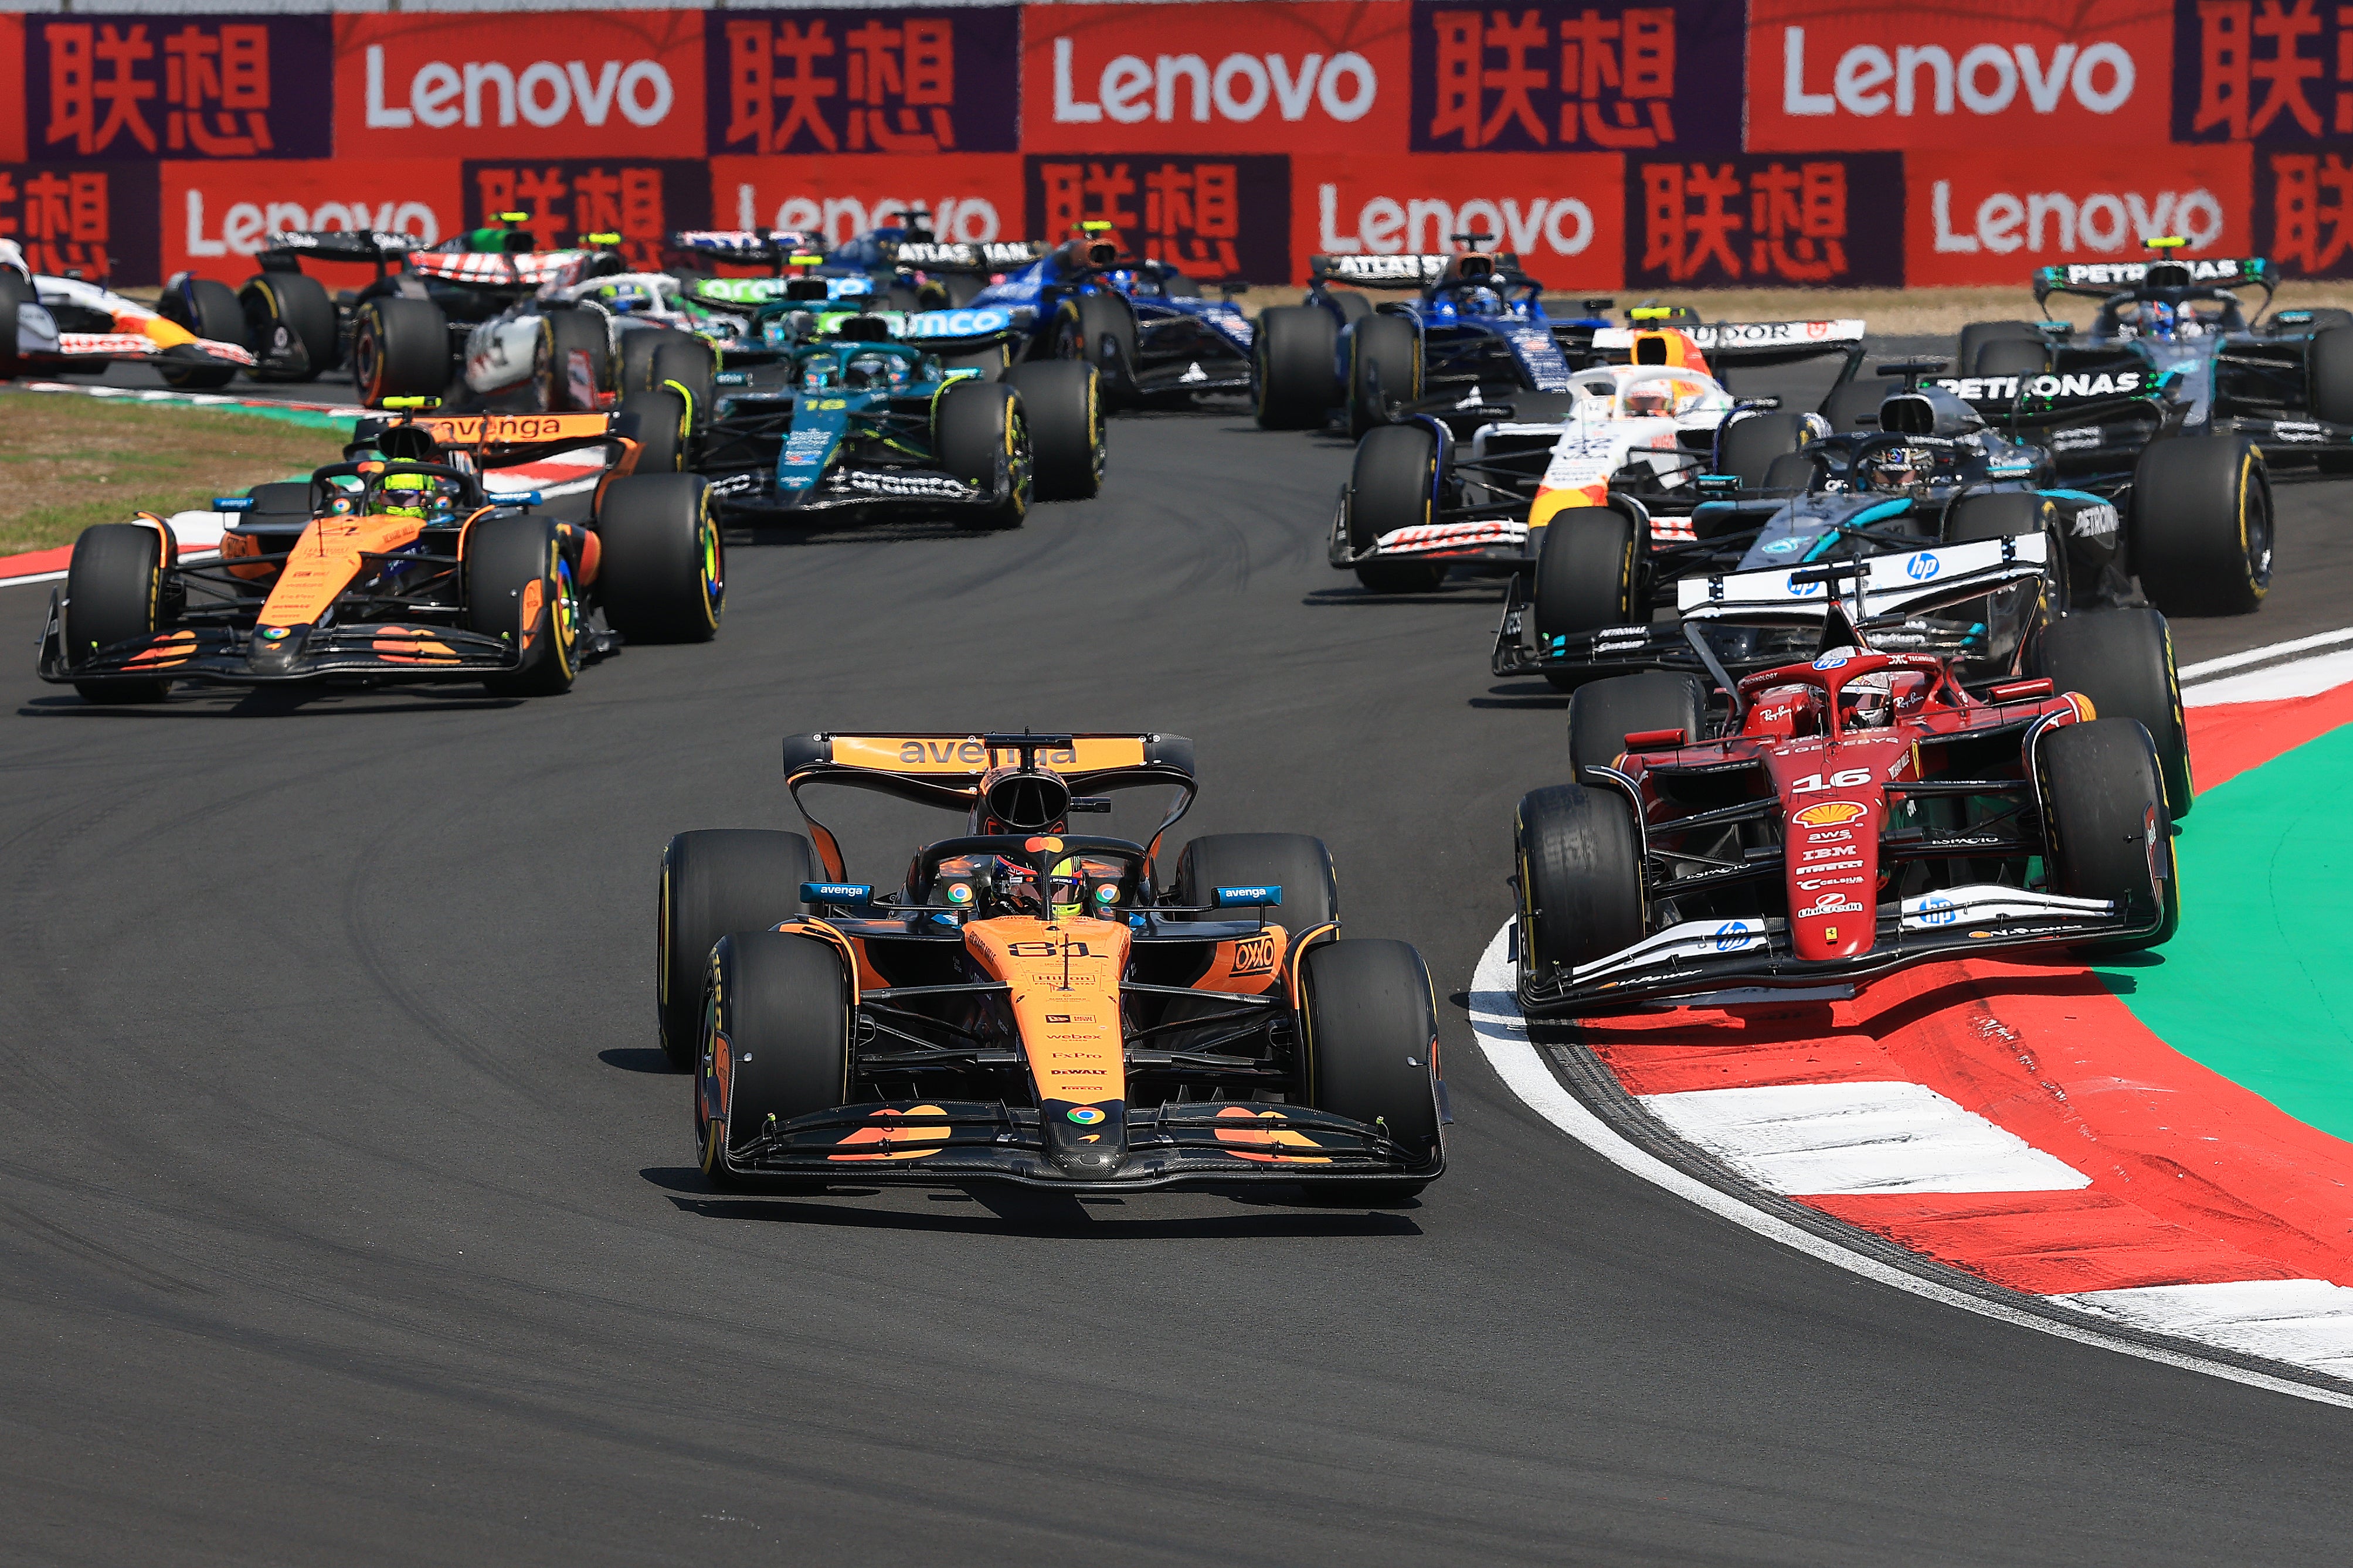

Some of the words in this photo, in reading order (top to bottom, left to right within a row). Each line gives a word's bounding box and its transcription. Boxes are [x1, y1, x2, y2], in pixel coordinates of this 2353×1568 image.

[44, 23, 274, 156] 联想
[365, 45, 674, 128] Lenovo
[725, 19, 957, 154] 联想
[1052, 37, 1377, 123] Lenovo
[1430, 8, 1677, 149] 联想
[1783, 26, 2136, 116] Lenovo
[2193, 0, 2353, 140] 联
[0, 172, 111, 281] 想
[185, 189, 438, 256] Lenovo
[1318, 183, 1594, 256] Lenovo
[1642, 161, 1849, 282] 联想
[1931, 179, 2224, 253] Lenovo
[441, 418, 560, 438] avnga
[1910, 553, 1937, 580] hp
[1792, 767, 1872, 794] 16
[1802, 845, 1857, 861] IBM
[1808, 829, 1851, 841] aws
[820, 886, 863, 897] avenga
[1225, 888, 1267, 898] avenga
[1798, 902, 1863, 919] UniCredit
[968, 930, 986, 955] RICHARD
[984, 945, 997, 967] MILLE
[1008, 942, 1109, 959] 81
[1235, 940, 1274, 970] OXXO
